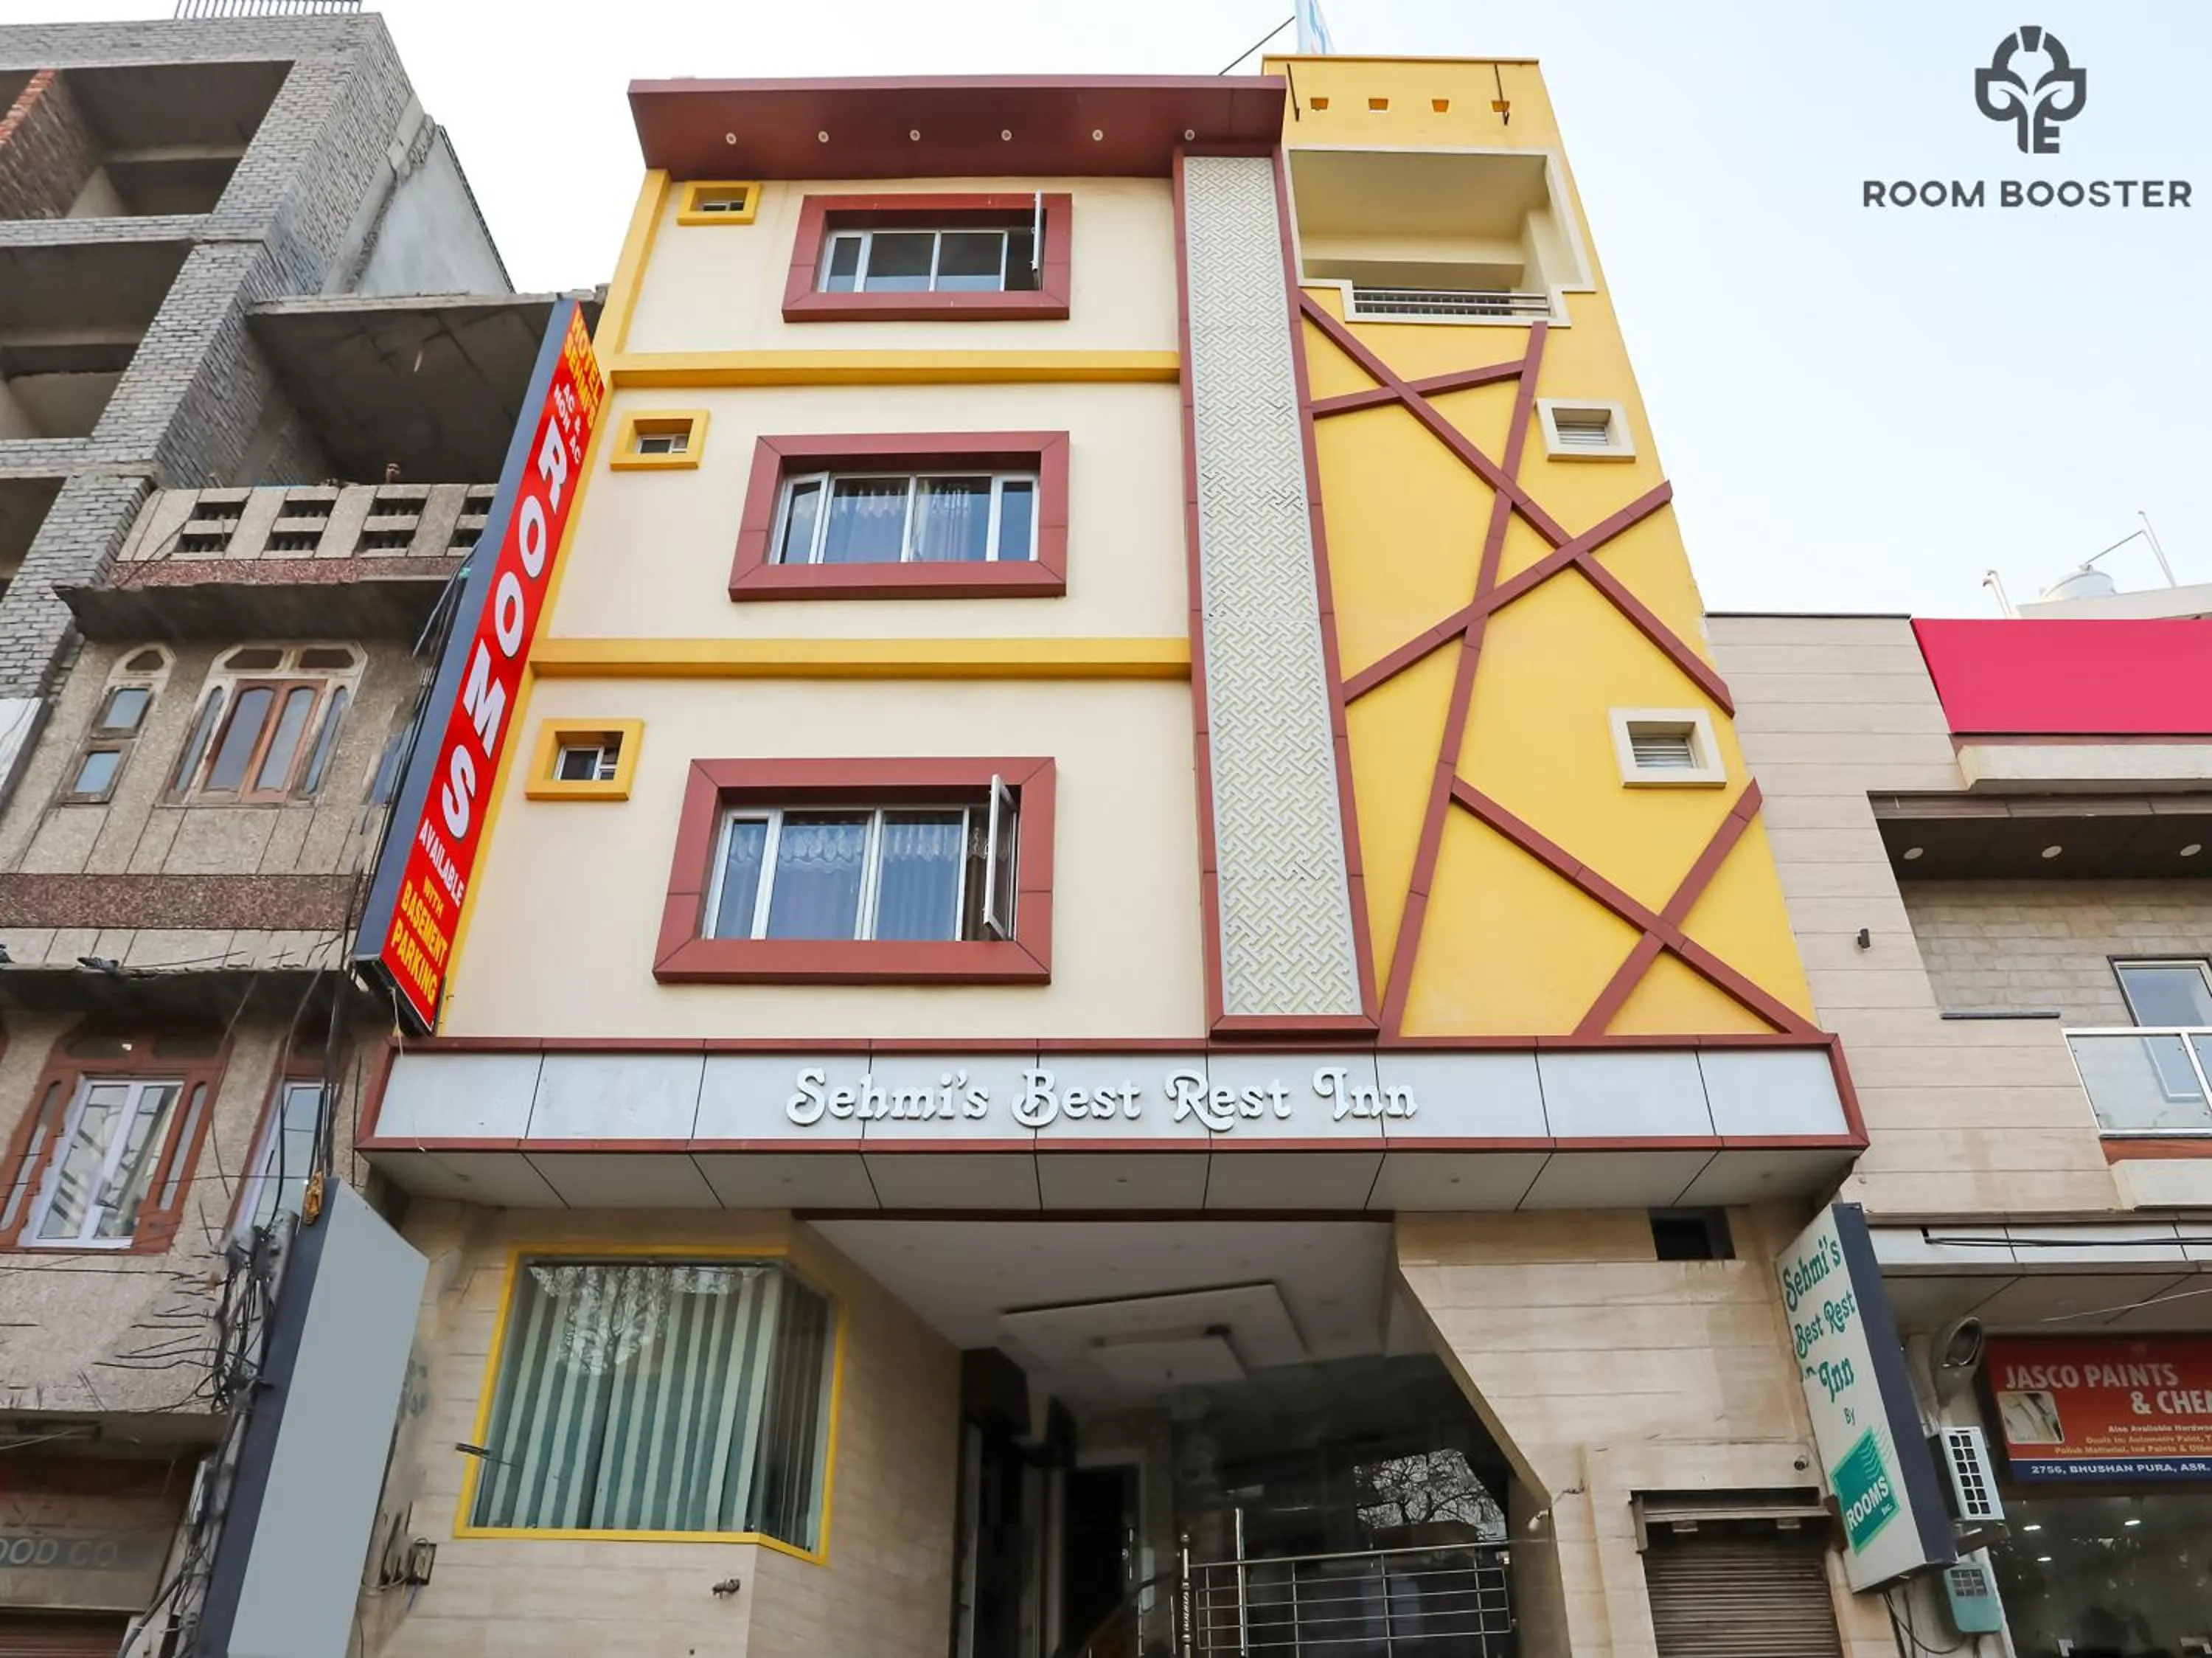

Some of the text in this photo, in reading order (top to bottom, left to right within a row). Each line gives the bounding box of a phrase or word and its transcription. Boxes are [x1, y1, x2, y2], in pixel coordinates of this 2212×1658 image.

[571, 305, 601, 406] HOTEL
[554, 383, 582, 465] NON AC
[564, 382, 574, 413] AC
[442, 414, 567, 839] ROOMS
[419, 816, 465, 908] AVAILABLE
[401, 879, 448, 968] BASEMENT
[423, 875, 444, 918] WITH
[391, 917, 438, 1006] PARKING
[786, 1066, 1419, 1131] Sehmi's Best Rest Inn
[1783, 1235, 1842, 1313] Sehmi's
[1795, 1289, 1857, 1359] Best Rest
[1819, 1357, 1854, 1402] Inn
[2006, 1363, 2180, 1389] JASCO PAINTS
[2130, 1391, 2152, 1415] &
[1844, 1407, 1856, 1426] By
[2131, 1424, 2172, 1432] Available
[2069, 1464, 2134, 1474] BHUSHAN
[2138, 1463, 2177, 1474] PURA,
[2180, 1463, 2211, 1472] ASR.
[1846, 1476, 1889, 1530] ROOMS
